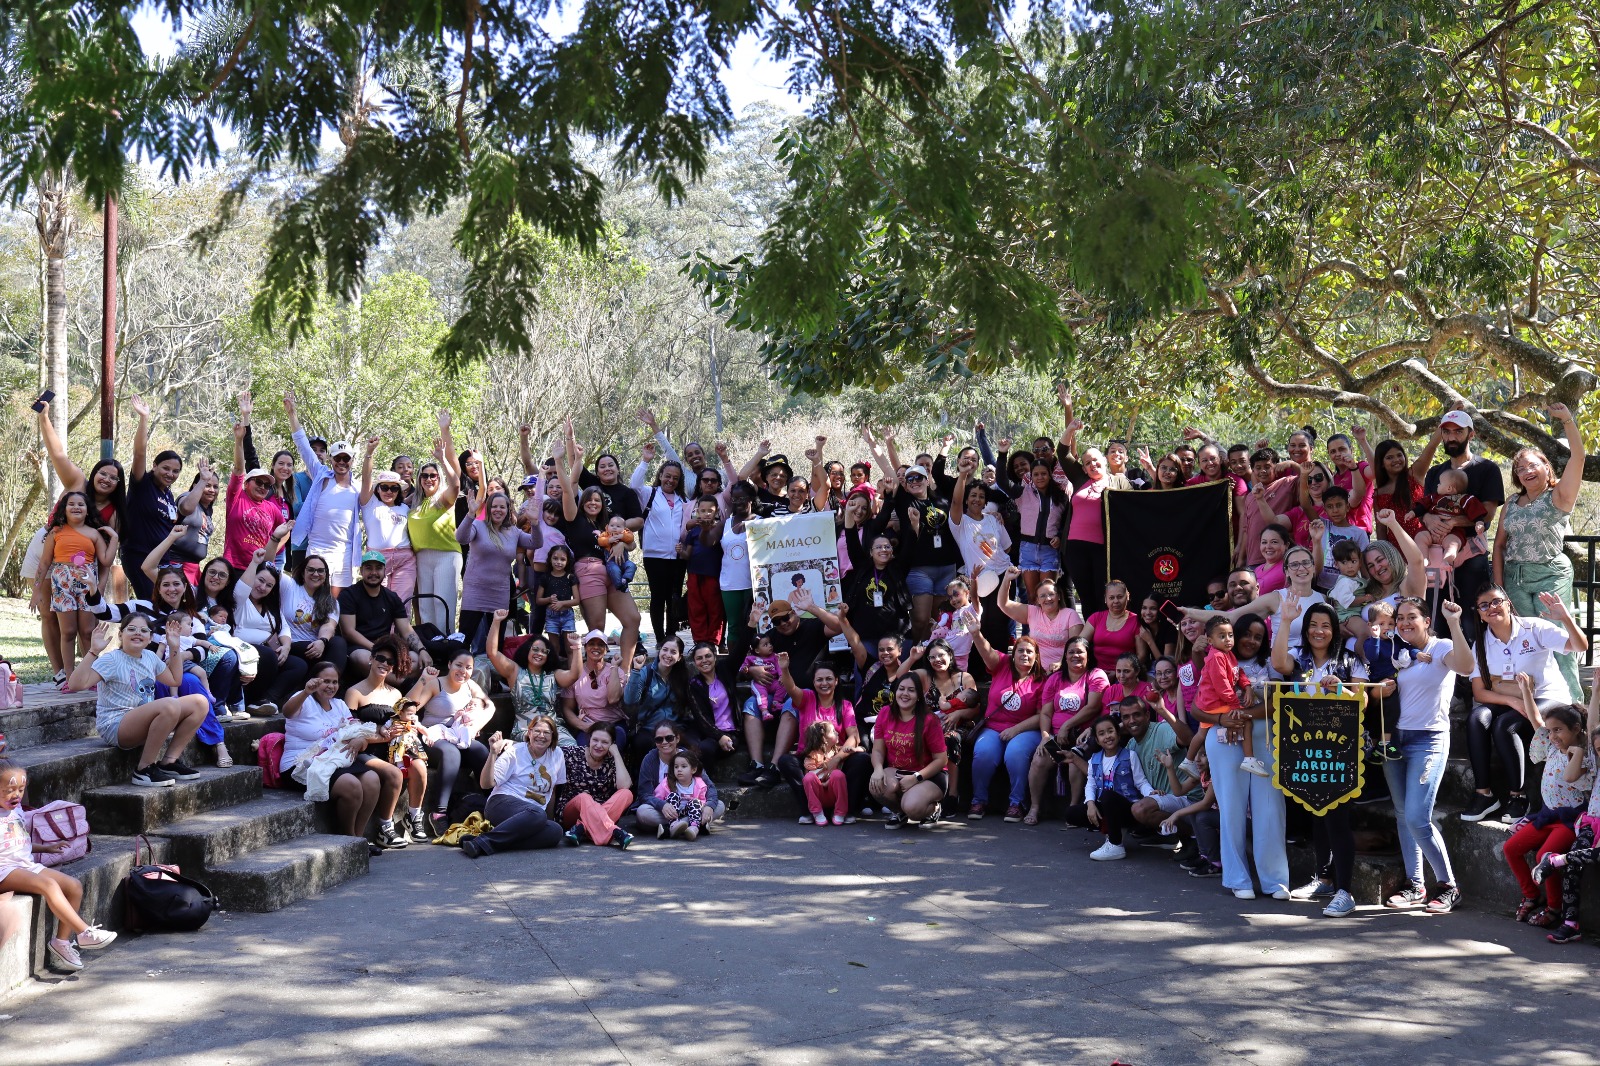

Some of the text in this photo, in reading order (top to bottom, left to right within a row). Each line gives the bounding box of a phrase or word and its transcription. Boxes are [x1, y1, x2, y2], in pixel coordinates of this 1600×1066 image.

[765, 535, 822, 551] MAMAÇO
[1290, 729, 1349, 745] GAAME
[1305, 748, 1333, 759] UBS
[1294, 761, 1346, 772] JARDIM
[1292, 772, 1345, 783] ROSELI
